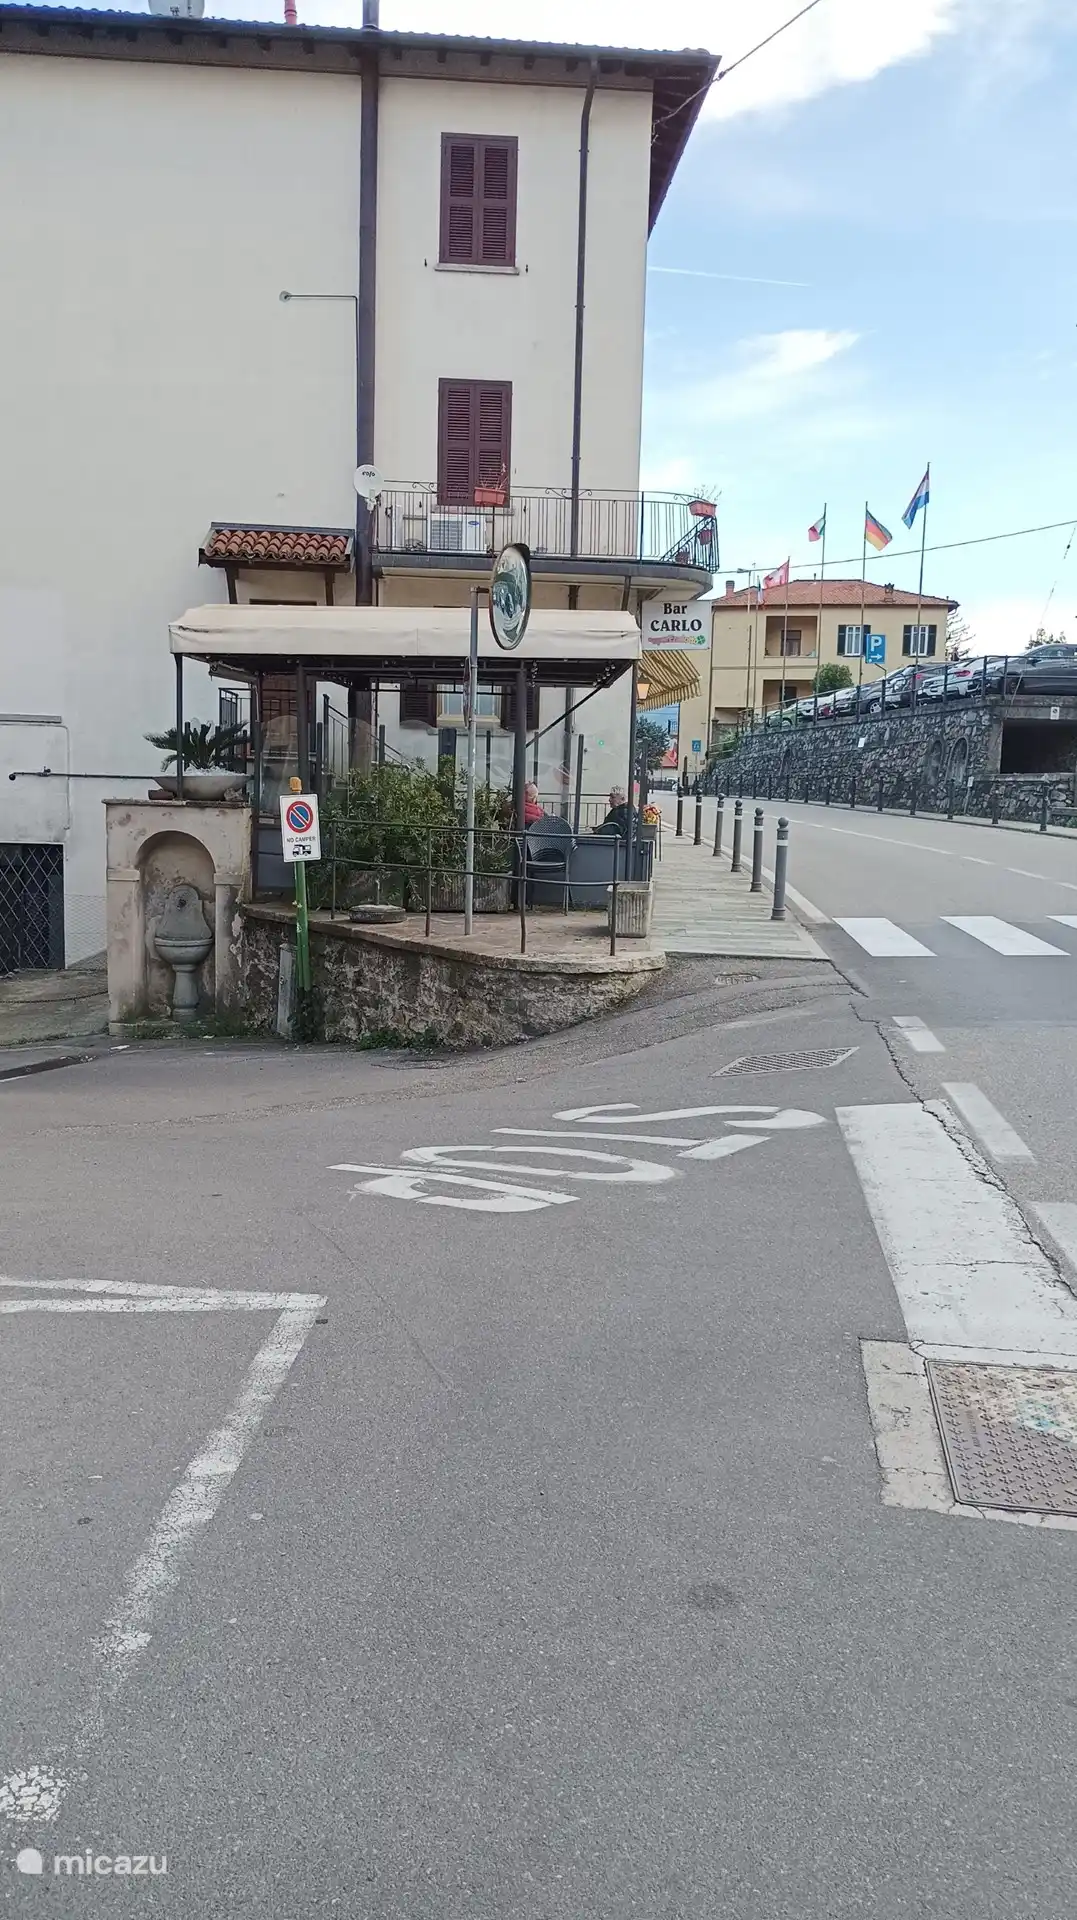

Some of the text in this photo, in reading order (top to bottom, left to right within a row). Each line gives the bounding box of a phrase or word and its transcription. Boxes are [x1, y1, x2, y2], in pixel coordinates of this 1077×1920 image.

[663, 602, 688, 615] Bar
[650, 619, 702, 632] CARLO
[870, 635, 882, 652] P
[325, 1102, 829, 1213] STOP
